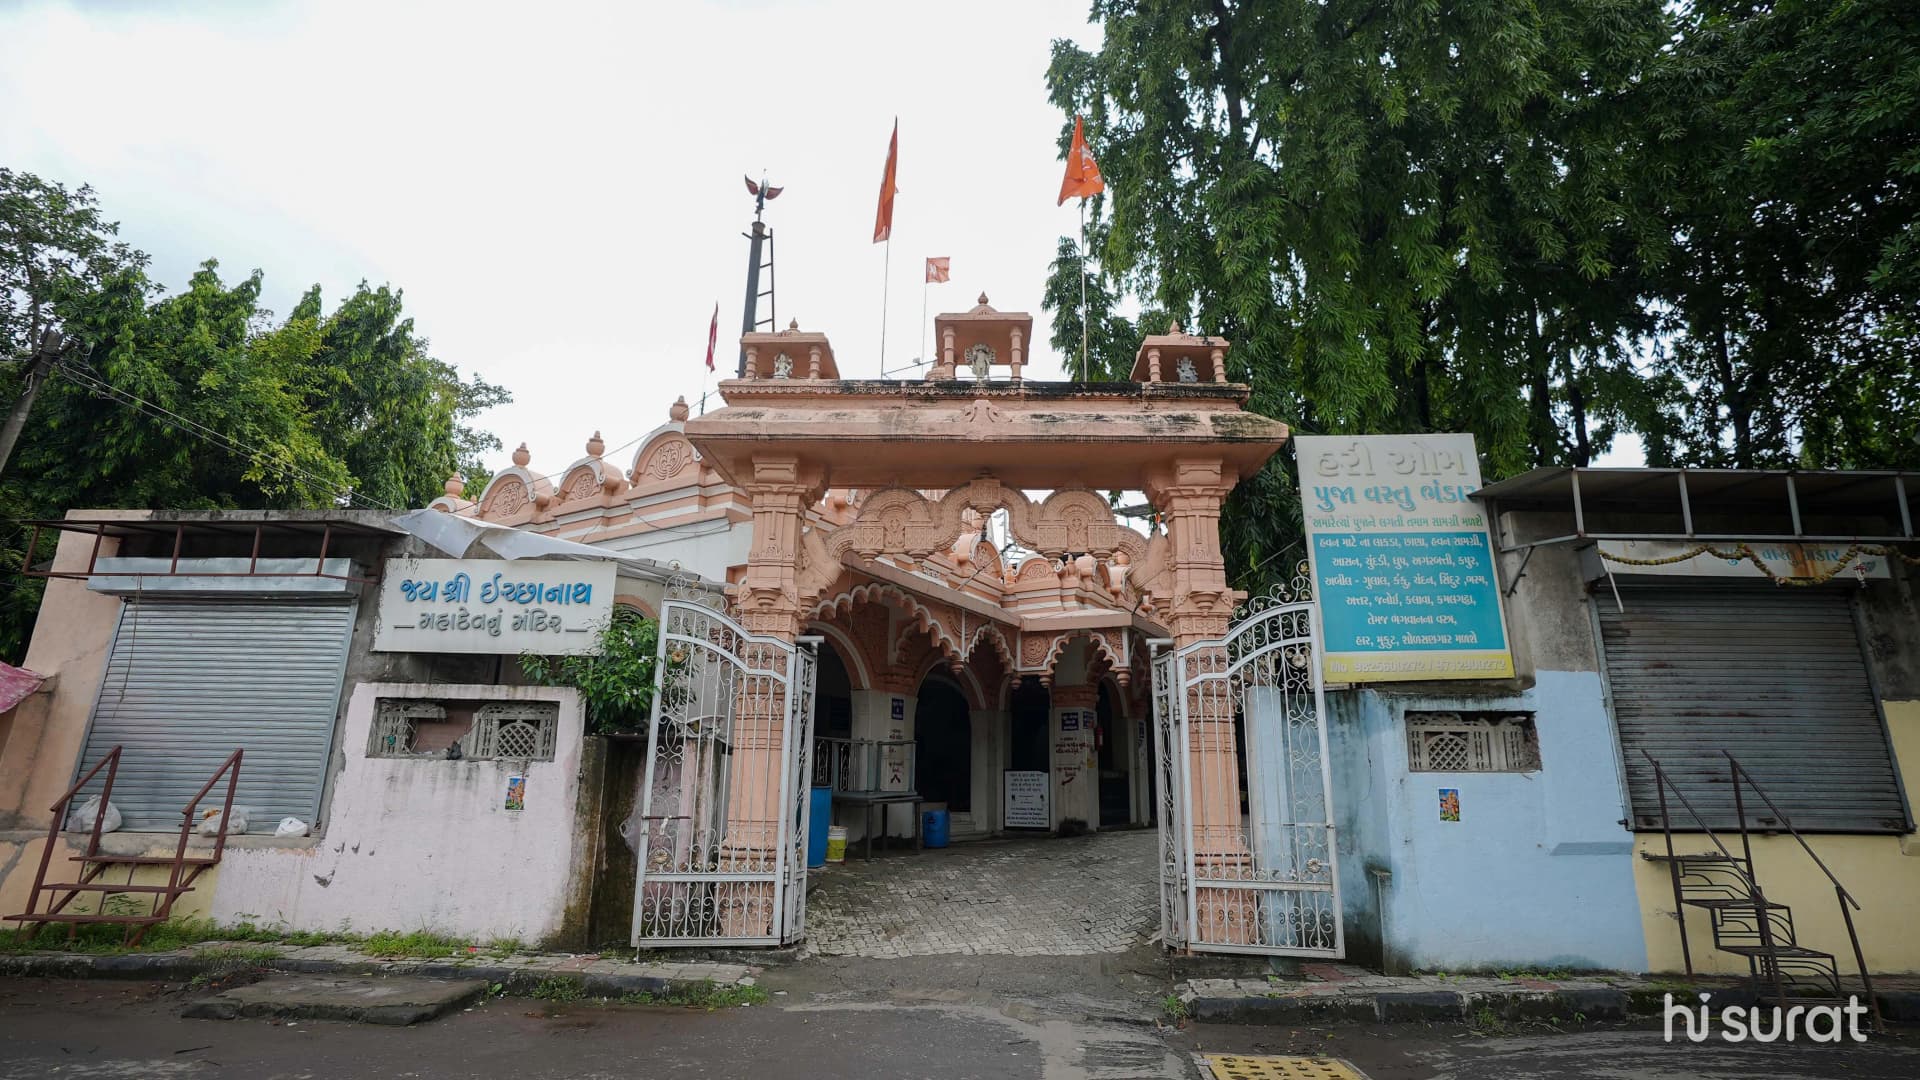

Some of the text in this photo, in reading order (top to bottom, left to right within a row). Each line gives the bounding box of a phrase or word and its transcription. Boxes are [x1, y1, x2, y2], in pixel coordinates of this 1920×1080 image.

[400, 572, 593, 605] જય શ્રી ઈચ્છાનાથ
[419, 607, 562, 636] મહાદેવનું મંદિર
